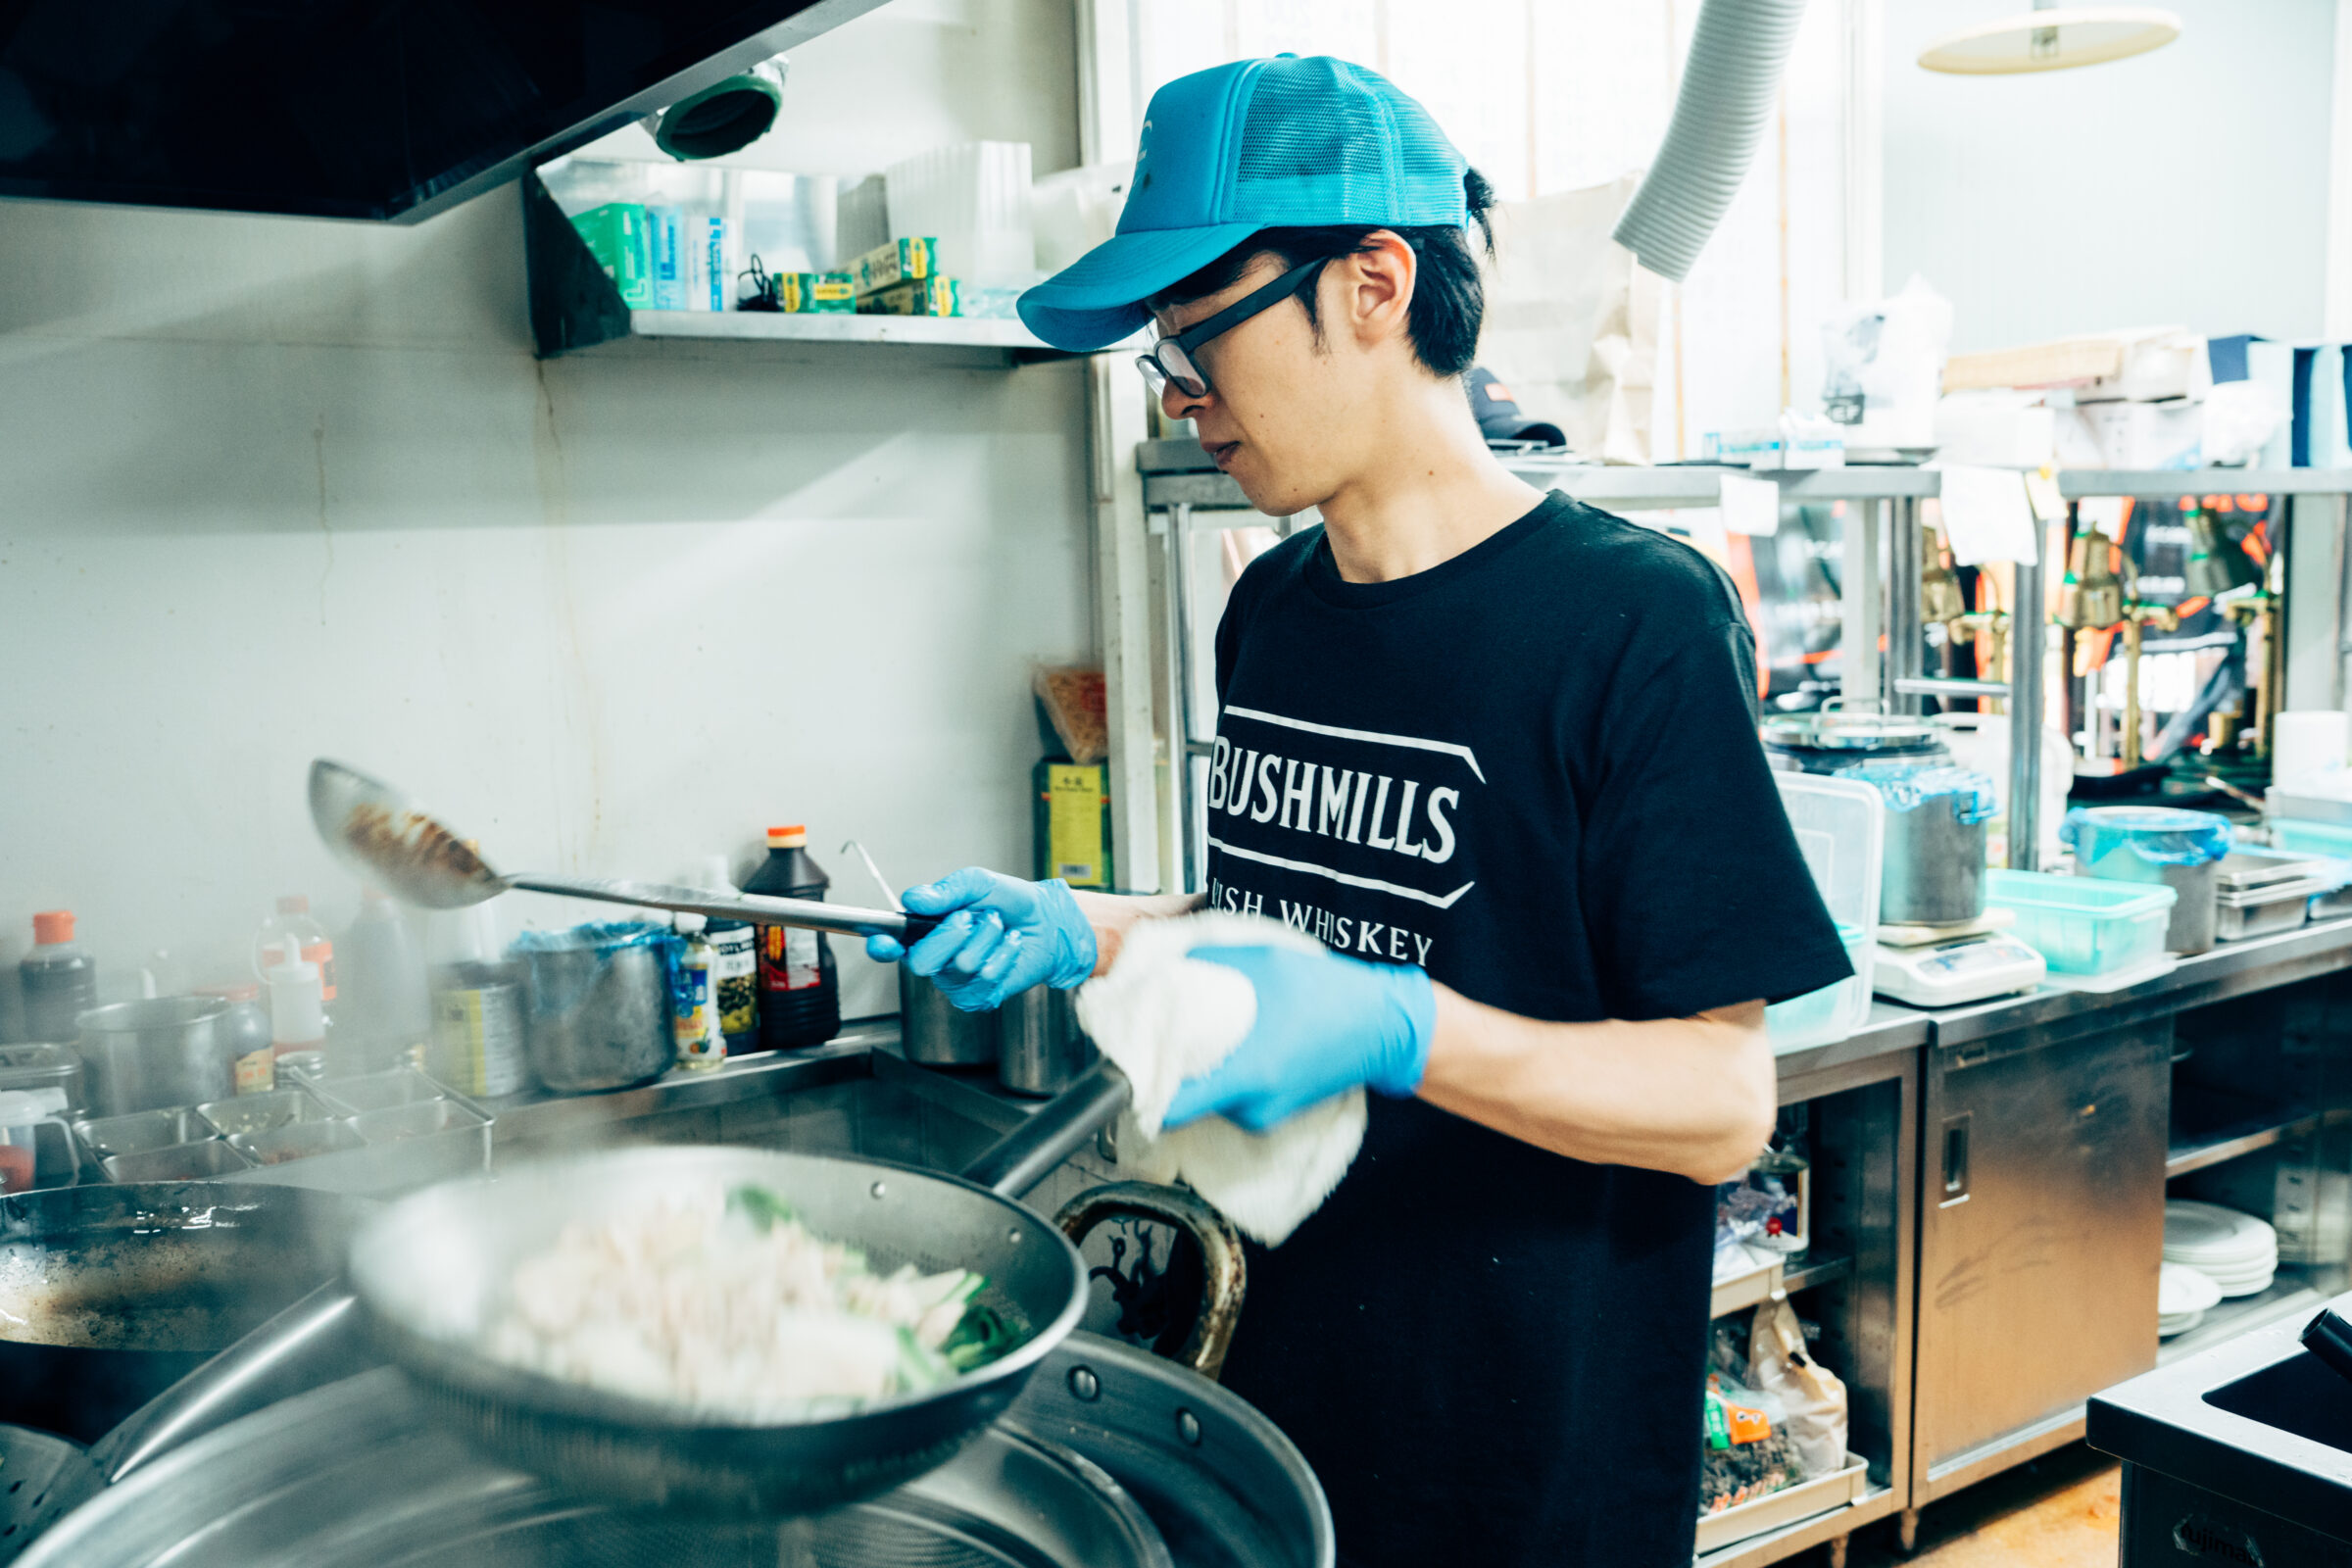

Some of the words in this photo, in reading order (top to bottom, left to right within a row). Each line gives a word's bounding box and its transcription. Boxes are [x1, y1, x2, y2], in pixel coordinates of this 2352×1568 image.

[1208, 736, 1460, 864] BUSHMILLS
[1211, 878, 1263, 920] RISH
[1279, 899, 1434, 967] WHISKEY
